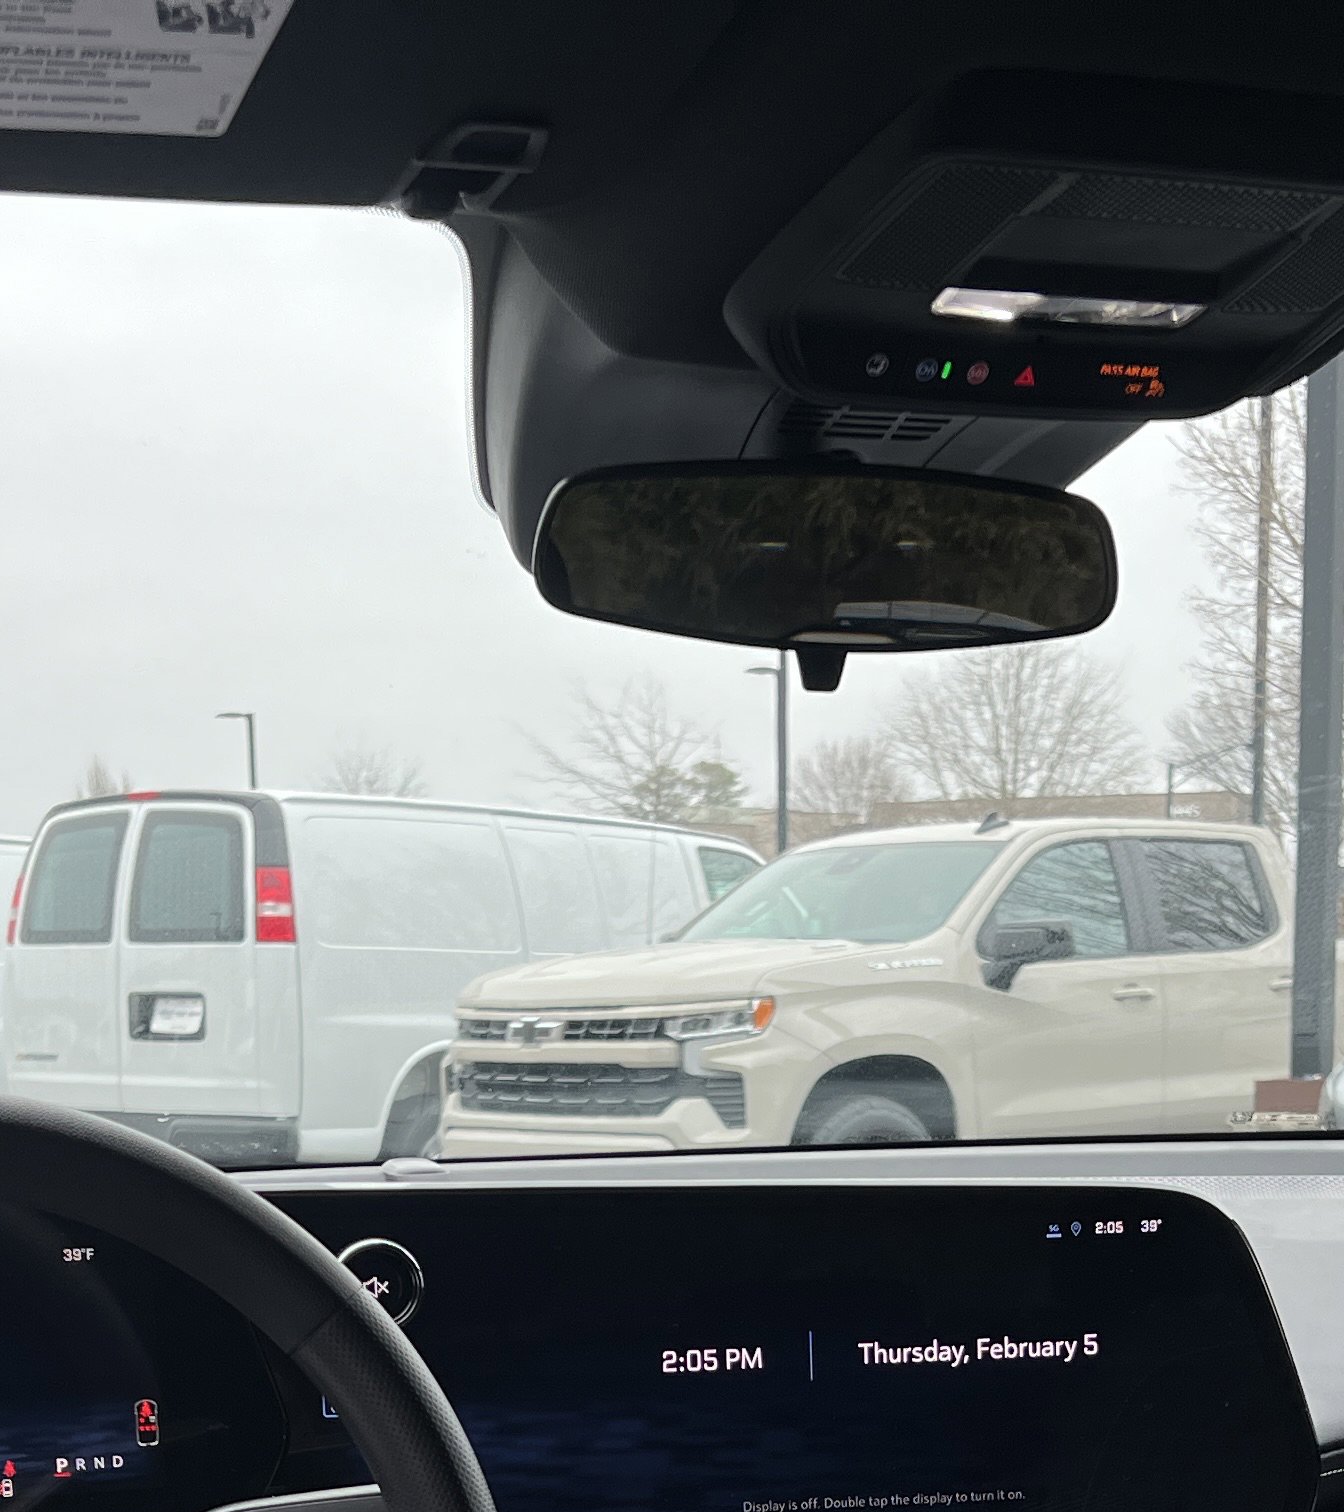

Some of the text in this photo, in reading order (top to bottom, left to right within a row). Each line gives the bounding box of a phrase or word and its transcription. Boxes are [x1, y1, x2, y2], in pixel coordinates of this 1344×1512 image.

[1095, 1219, 1162, 1234] 2:05 39°
[62, 1247, 95, 1262] 39°F
[662, 1347, 763, 1372] 2:05 PM
[858, 1333, 1098, 1367] Thursday, February 5
[56, 1455, 124, 1473] P R N D
[788, 1499, 798, 1511] is
[824, 1496, 865, 1509] Double
[868, 1495, 888, 1509] tap
[890, 1494, 910, 1506] the
[913, 1491, 953, 1506] display
[956, 1492, 968, 1503] to
[970, 1491, 994, 1502] turn
[997, 1490, 1005, 1500] it
[1008, 1490, 1026, 1500] on.
